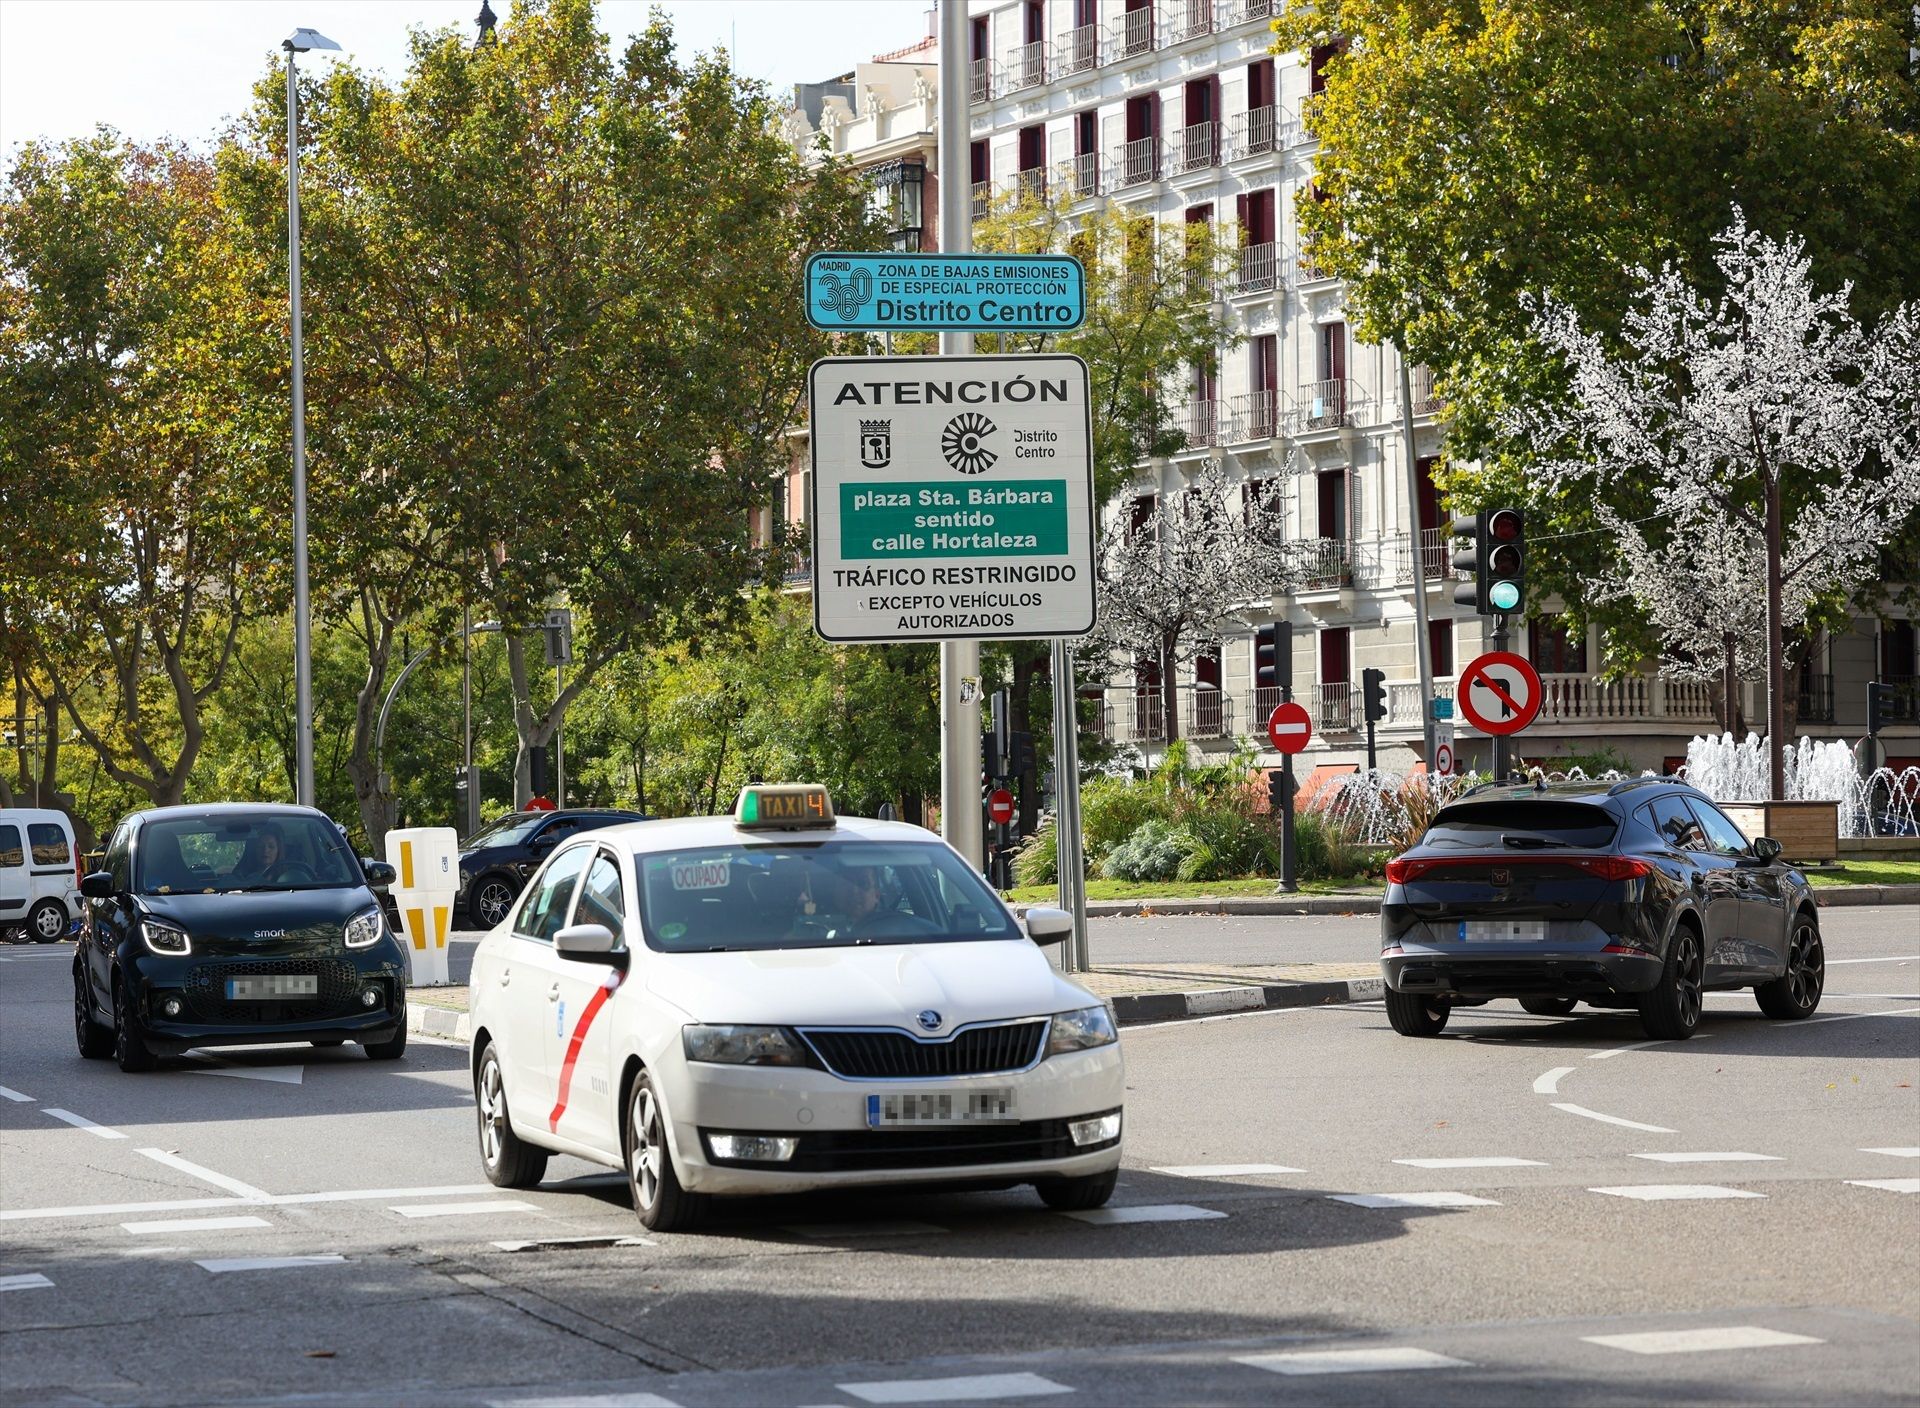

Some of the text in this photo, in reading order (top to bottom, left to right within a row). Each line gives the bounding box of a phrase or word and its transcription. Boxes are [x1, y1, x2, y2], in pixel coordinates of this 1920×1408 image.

[819, 261, 851, 272] MADRID
[878, 265, 1069, 279] ZONA DE BAJAS EMISIONES
[818, 267, 873, 321] 360
[881, 280, 1067, 295] DE ESPECIAL PROTECCIÓN
[877, 299, 1072, 322] Distrito Centro
[833, 375, 1068, 406] ATENCIÓN
[1013, 429, 1058, 443] Distrito
[1015, 445, 1055, 458] Centro
[854, 488, 1053, 510] plaza Sta. Bárbara
[914, 510, 995, 528] sentido
[872, 532, 1037, 550] calle Hortaleza
[833, 565, 1076, 587] TRÁFICO RESTRINGIDO
[869, 591, 1042, 610] EXCEPTO VEHÍCULOS
[897, 613, 1014, 629] AUTORIZADOS
[763, 797, 803, 817] TAXI
[808, 794, 824, 817] 4
[675, 864, 727, 888] OCUPADO
[254, 928, 286, 938] smart
